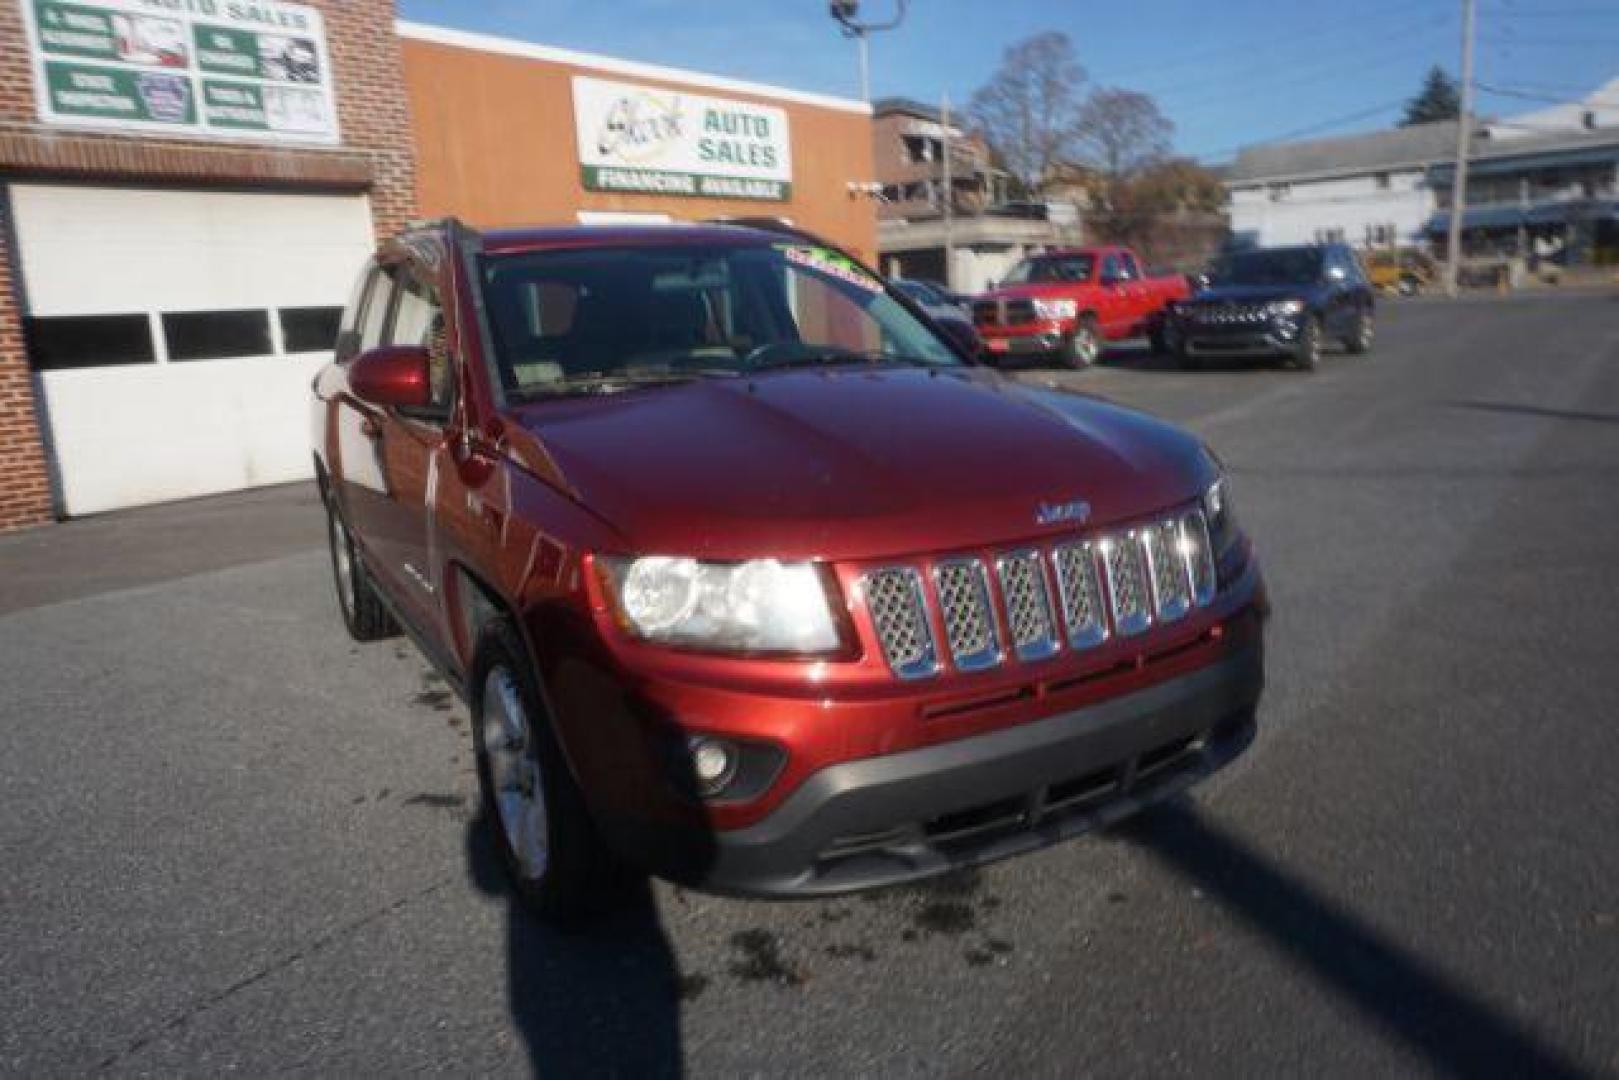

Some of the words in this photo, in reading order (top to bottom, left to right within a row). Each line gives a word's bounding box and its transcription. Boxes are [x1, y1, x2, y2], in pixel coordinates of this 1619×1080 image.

[225, 3, 308, 28] SALES
[704, 109, 771, 138] AUTO
[698, 138, 778, 168] SALES
[597, 169, 696, 194] FINANCING
[700, 178, 784, 200] AVAILABLE
